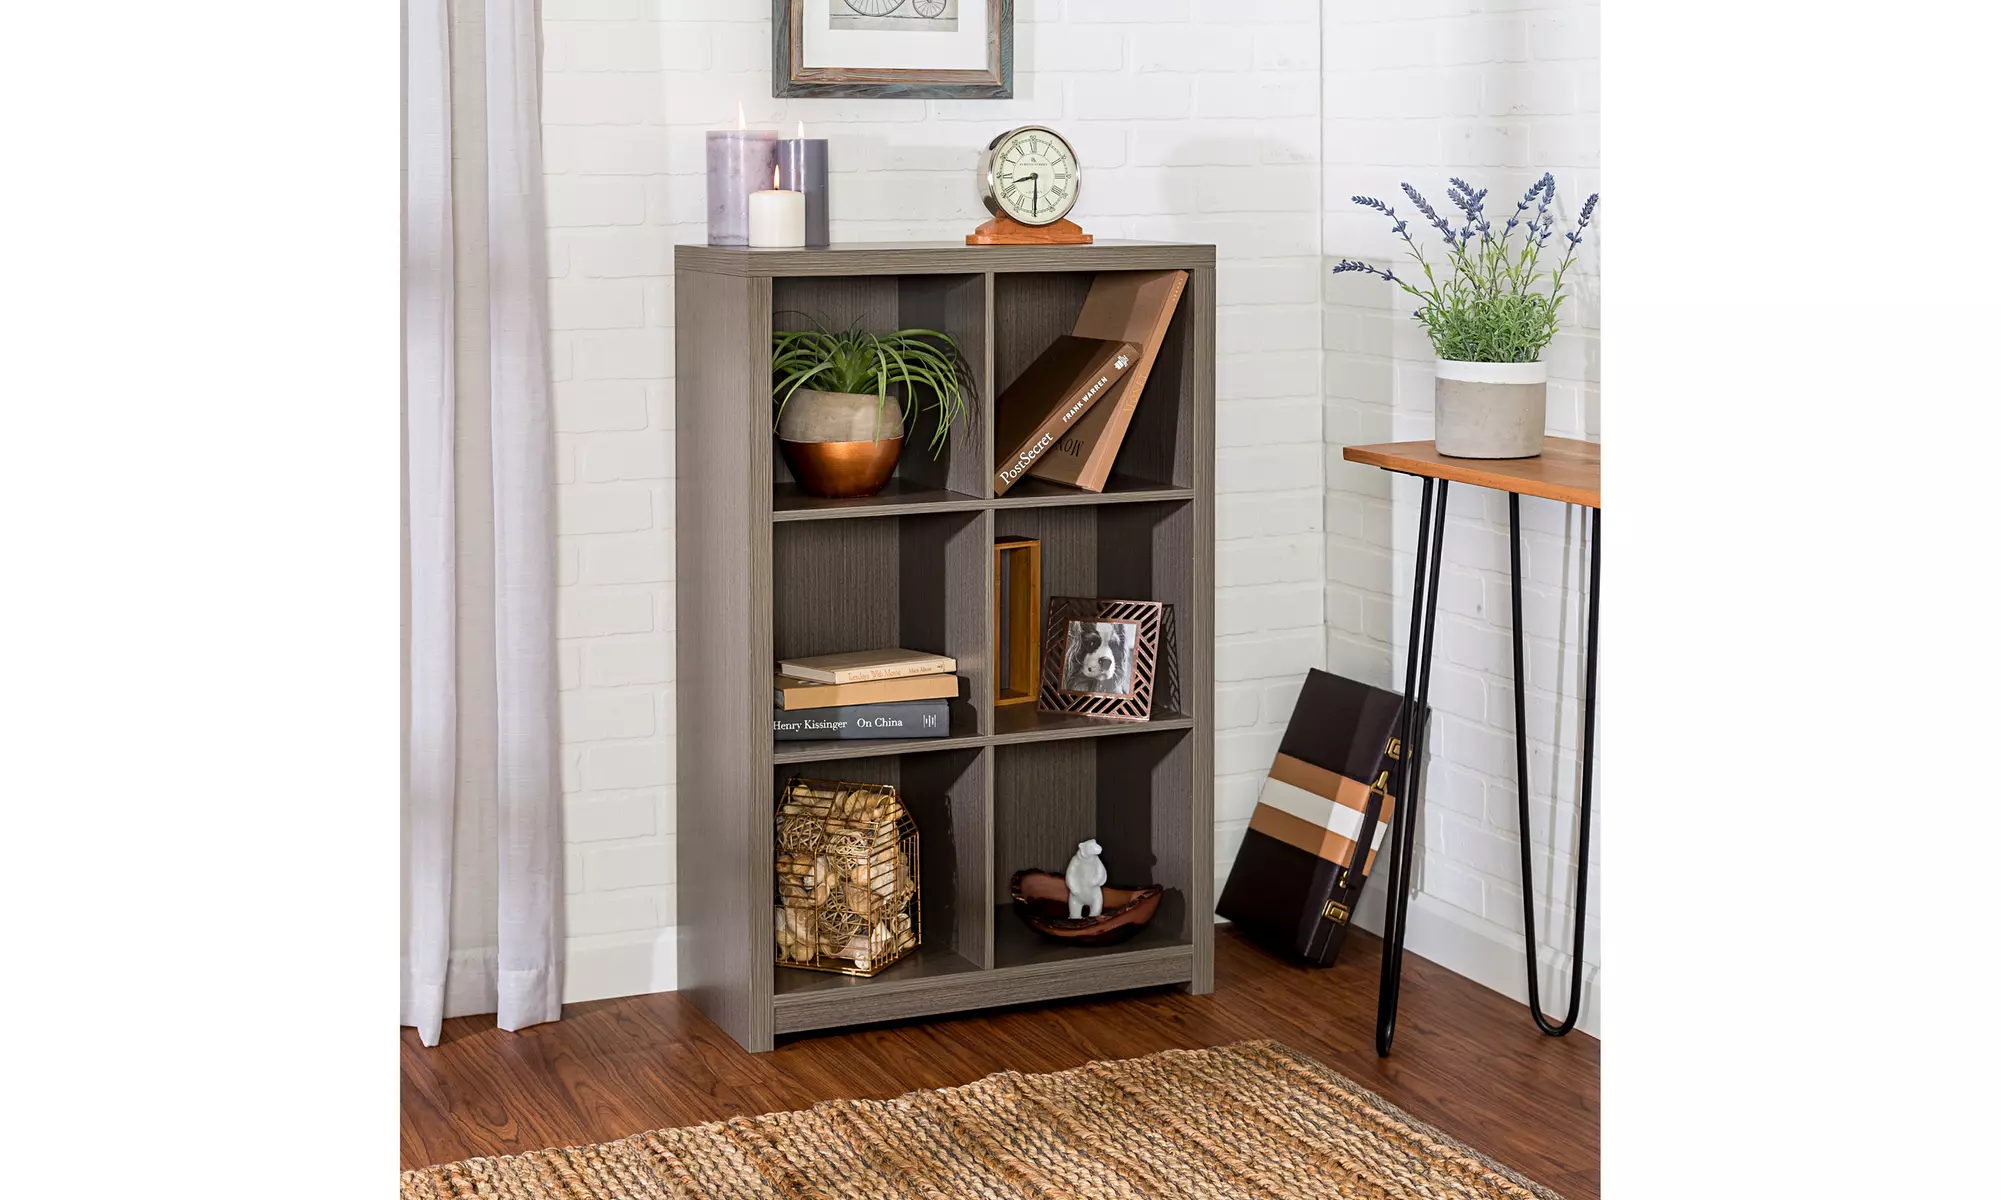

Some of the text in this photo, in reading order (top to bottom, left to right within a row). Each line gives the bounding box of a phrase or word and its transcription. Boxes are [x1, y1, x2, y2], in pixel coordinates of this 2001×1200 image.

[1062, 376, 1108, 423] FRANK WARREN
[1000, 432, 1054, 486] PostSecret
[773, 719, 848, 732] Henry Kissinger
[857, 717, 904, 728] On China
